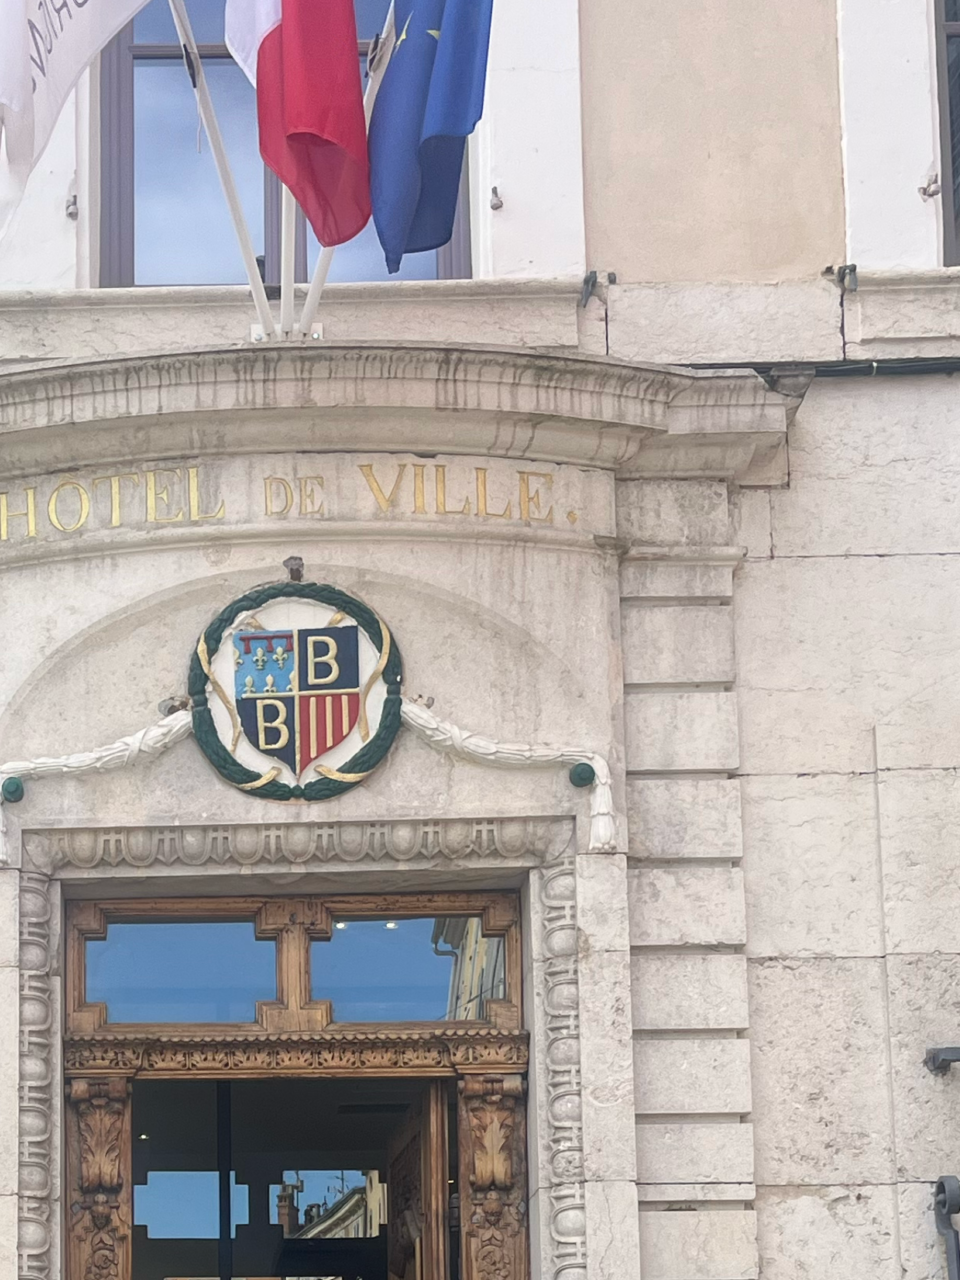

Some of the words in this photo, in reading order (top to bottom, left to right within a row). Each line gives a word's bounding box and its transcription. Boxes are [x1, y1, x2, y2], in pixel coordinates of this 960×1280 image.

[263, 475, 326, 518] DE
[307, 635, 340, 685] B
[256, 699, 289, 750] B
